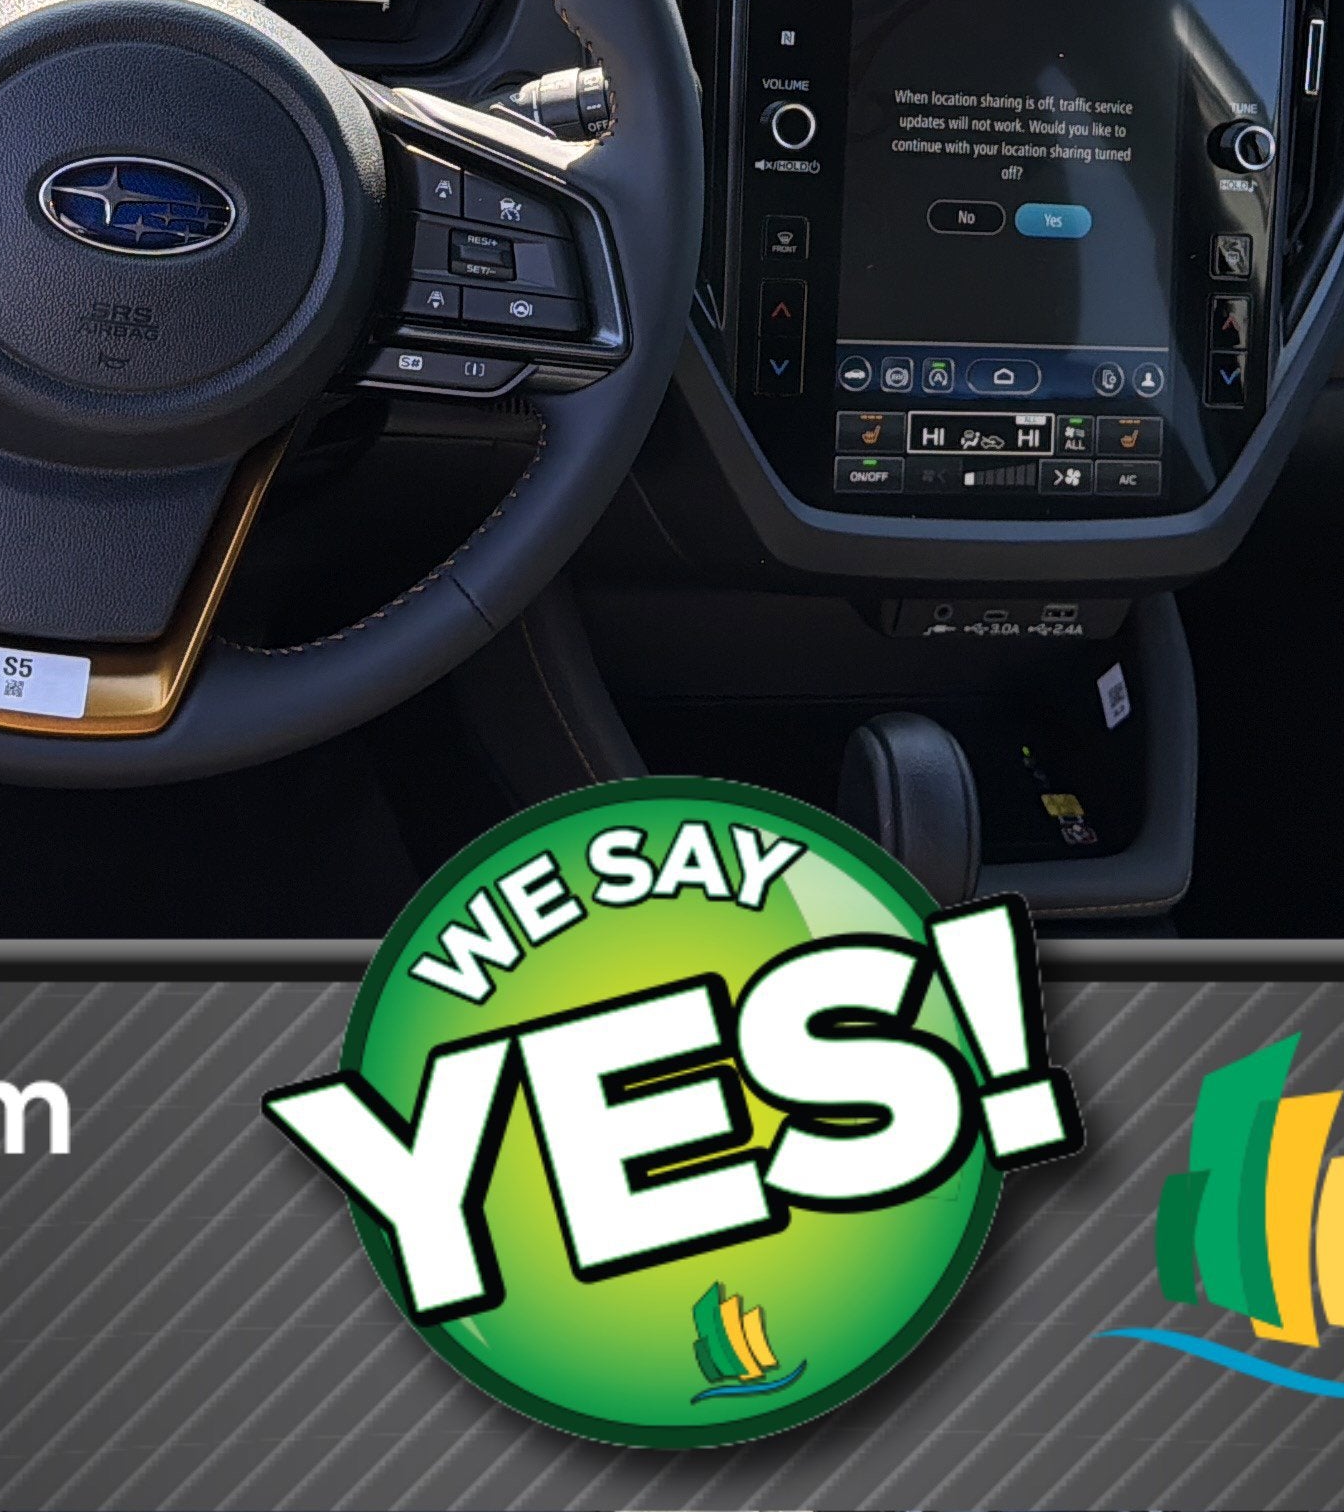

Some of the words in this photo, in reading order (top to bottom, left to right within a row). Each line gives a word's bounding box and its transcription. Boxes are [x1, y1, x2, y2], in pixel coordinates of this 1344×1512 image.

[762, 78, 810, 92] VOLUME
[894, 89, 928, 105] When
[931, 90, 977, 107] location
[980, 94, 1023, 112] sharing
[1025, 96, 1035, 110] is
[1037, 96, 1056, 113] off,
[1059, 97, 1092, 113] traffic
[1095, 99, 1133, 115] service
[1230, 102, 1258, 115] TUNE
[899, 114, 945, 131] updates
[948, 116, 969, 130] will
[972, 117, 991, 132] not
[994, 118, 1025, 134] work.
[1029, 119, 1065, 135] Would
[1069, 123, 1089, 138] you
[1092, 122, 1112, 137] like
[1114, 123, 1127, 138] to
[892, 138, 943, 154] continue
[945, 139, 970, 155] with
[973, 142, 998, 159] your
[1001, 141, 1047, 158] location
[1049, 144, 1092, 163] sharing
[1094, 146, 1132, 162] turned
[777, 160, 809, 172] HOLD
[1001, 166, 1024, 181] off?
[958, 209, 976, 225] No
[1044, 213, 1063, 228] Yes
[771, 245, 797, 254] FRONT
[922, 427, 945, 447] HI
[1017, 429, 1040, 448] HI
[1064, 439, 1086, 450] ALL
[849, 471, 889, 483] ON/OFF
[1119, 474, 1138, 486] A/C
[3, 656, 33, 678] S5
